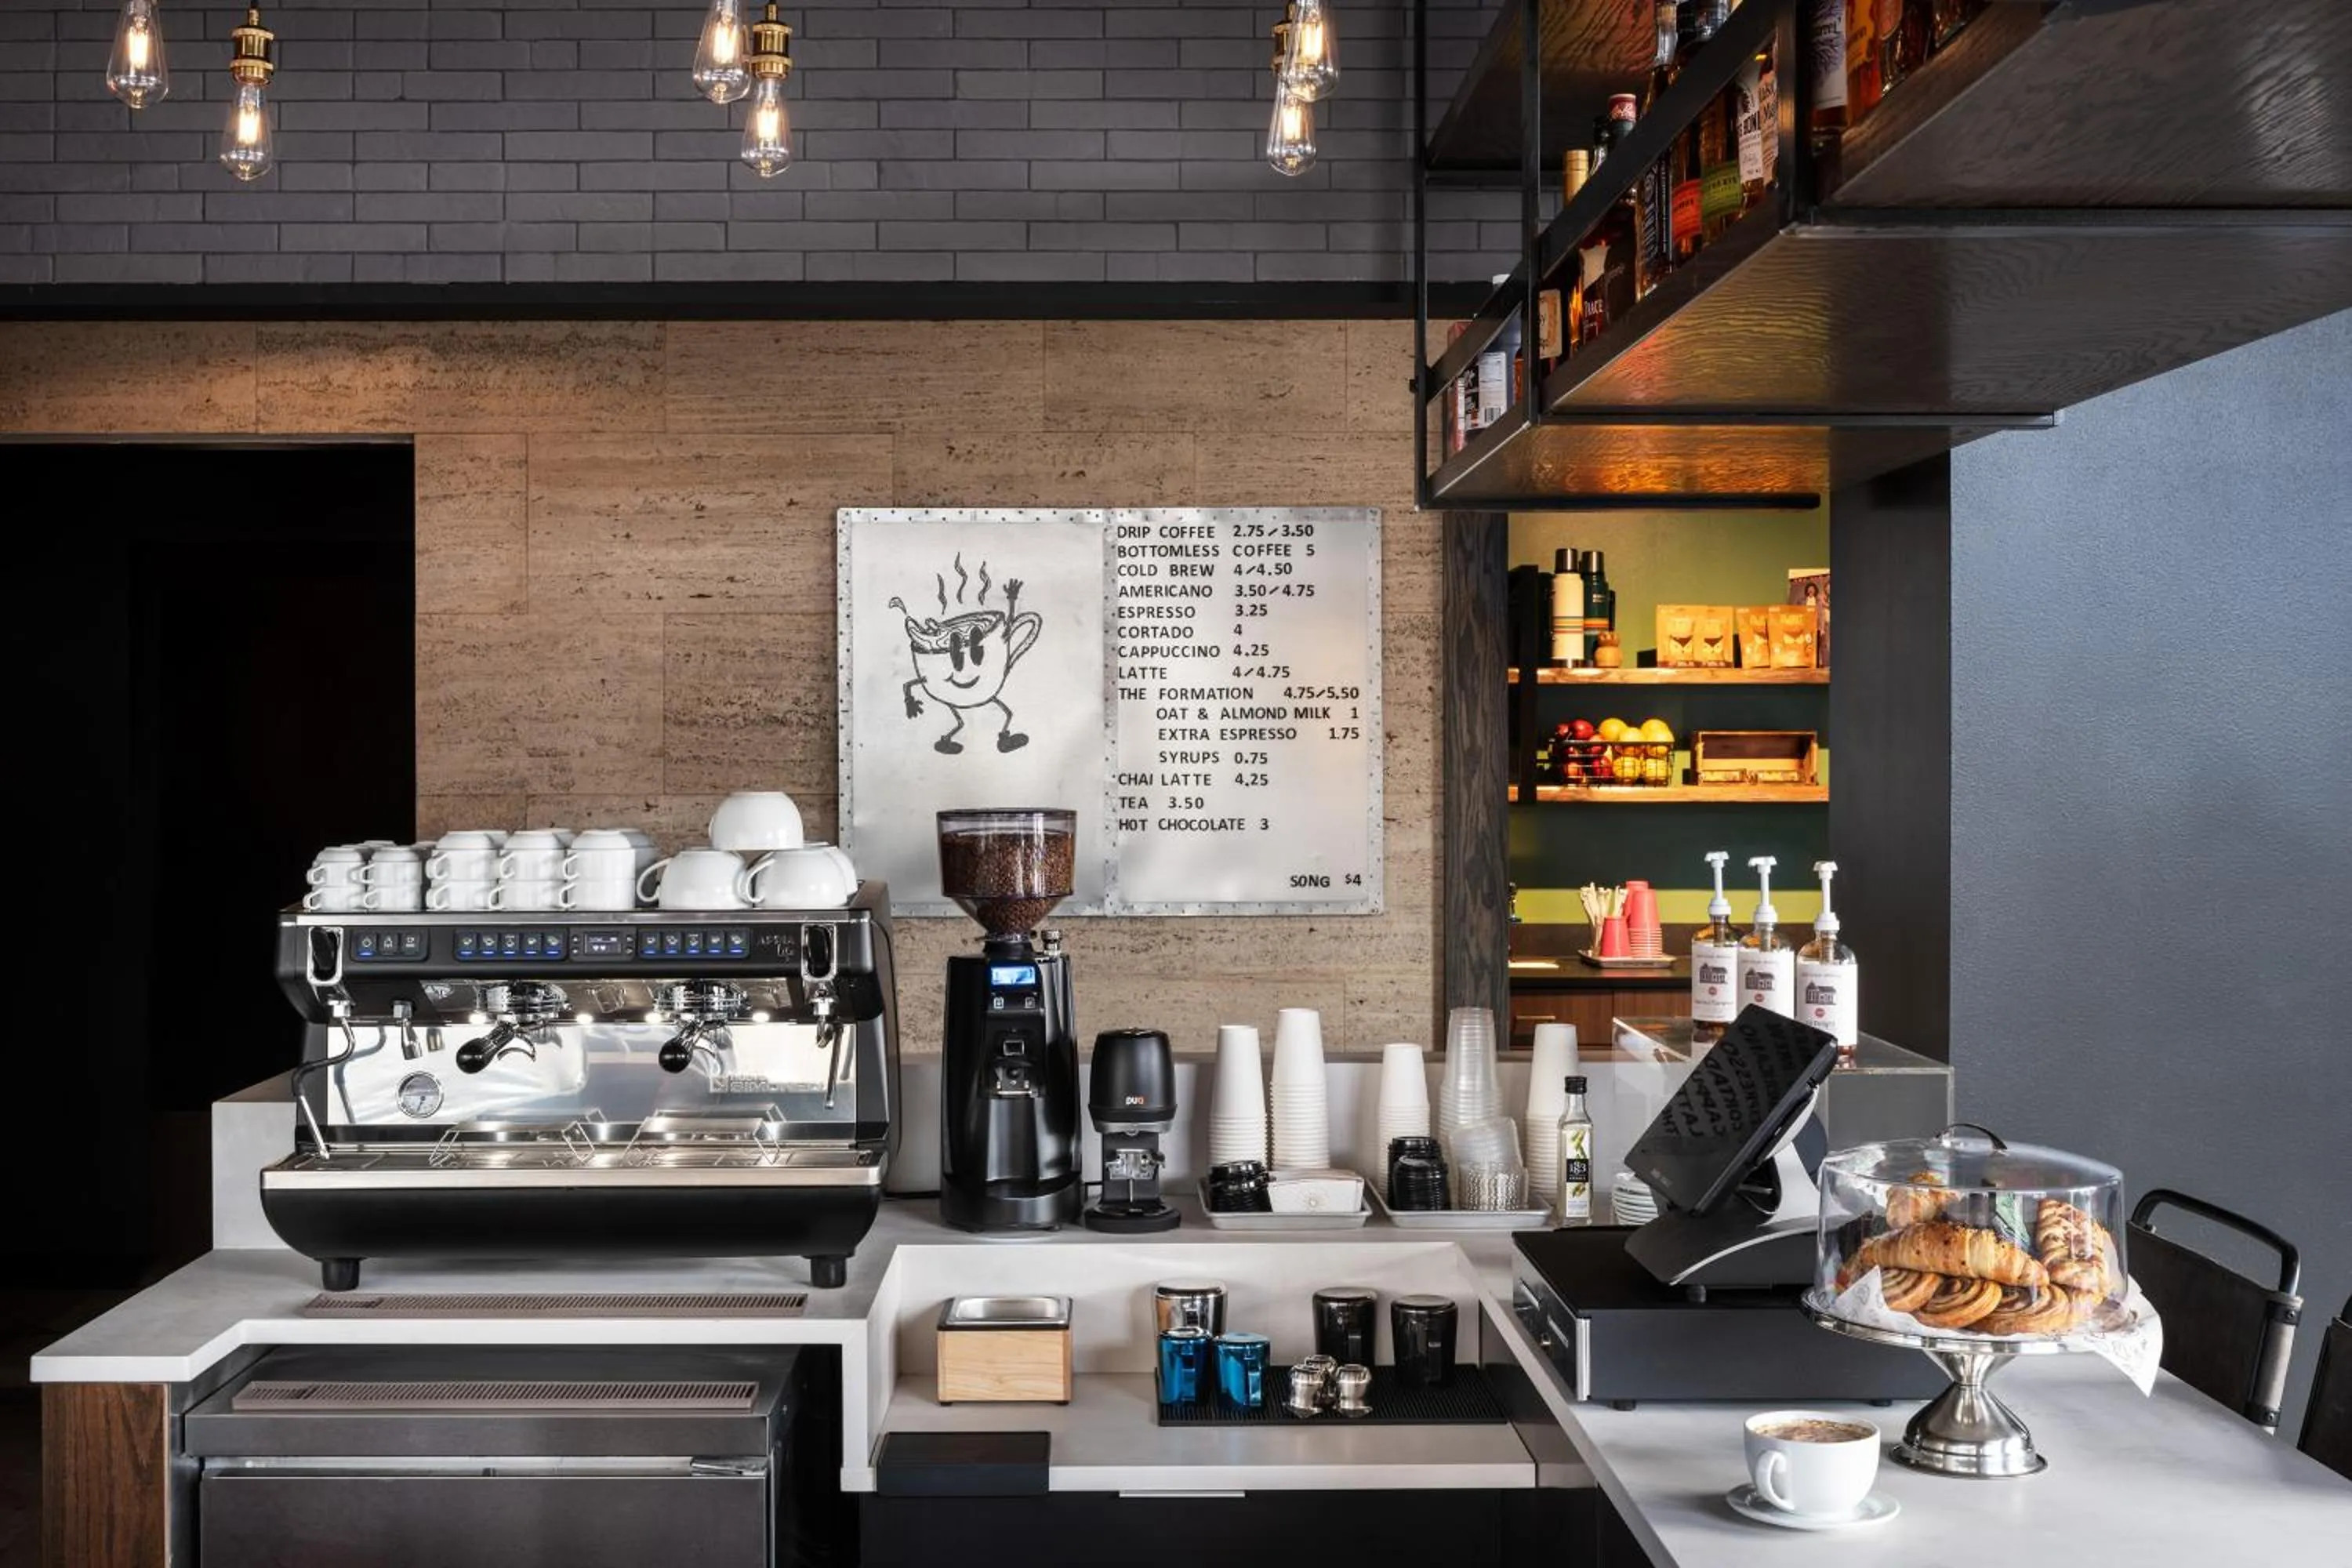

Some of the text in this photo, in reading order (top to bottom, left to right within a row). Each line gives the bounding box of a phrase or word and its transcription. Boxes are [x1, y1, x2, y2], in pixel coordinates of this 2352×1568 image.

[1116, 525, 1151, 539] DRIP
[1159, 525, 1216, 539] COFFEE
[1117, 543, 1316, 559] BOTTOMLESS COFFEE 5
[1117, 564, 1158, 577] COLD
[1169, 564, 1215, 578] BREW
[1118, 584, 1213, 598] AMERICANO
[1117, 603, 1268, 619] ESPRESSO 3.25
[1116, 623, 1243, 639] CORTADO 4
[1116, 643, 1270, 659] CAPPUCCINO 4.25
[1119, 666, 1167, 680] LATTE
[1118, 688, 1147, 700] THE
[1159, 687, 1254, 701] FORMATION
[1156, 706, 1359, 720] OAT & ALMOND MILK 1
[1158, 727, 1360, 741] EXTRA ESPRESSO 1.75
[1159, 750, 1268, 765] SYRUPS 0.75
[1117, 772, 1269, 787] CHAI LATTE 4.25
[1118, 796, 1205, 810] TEA 3.50
[1116, 818, 1269, 832] HOT CHOCOLATE 3
[1290, 873, 1362, 888] SONG $4
